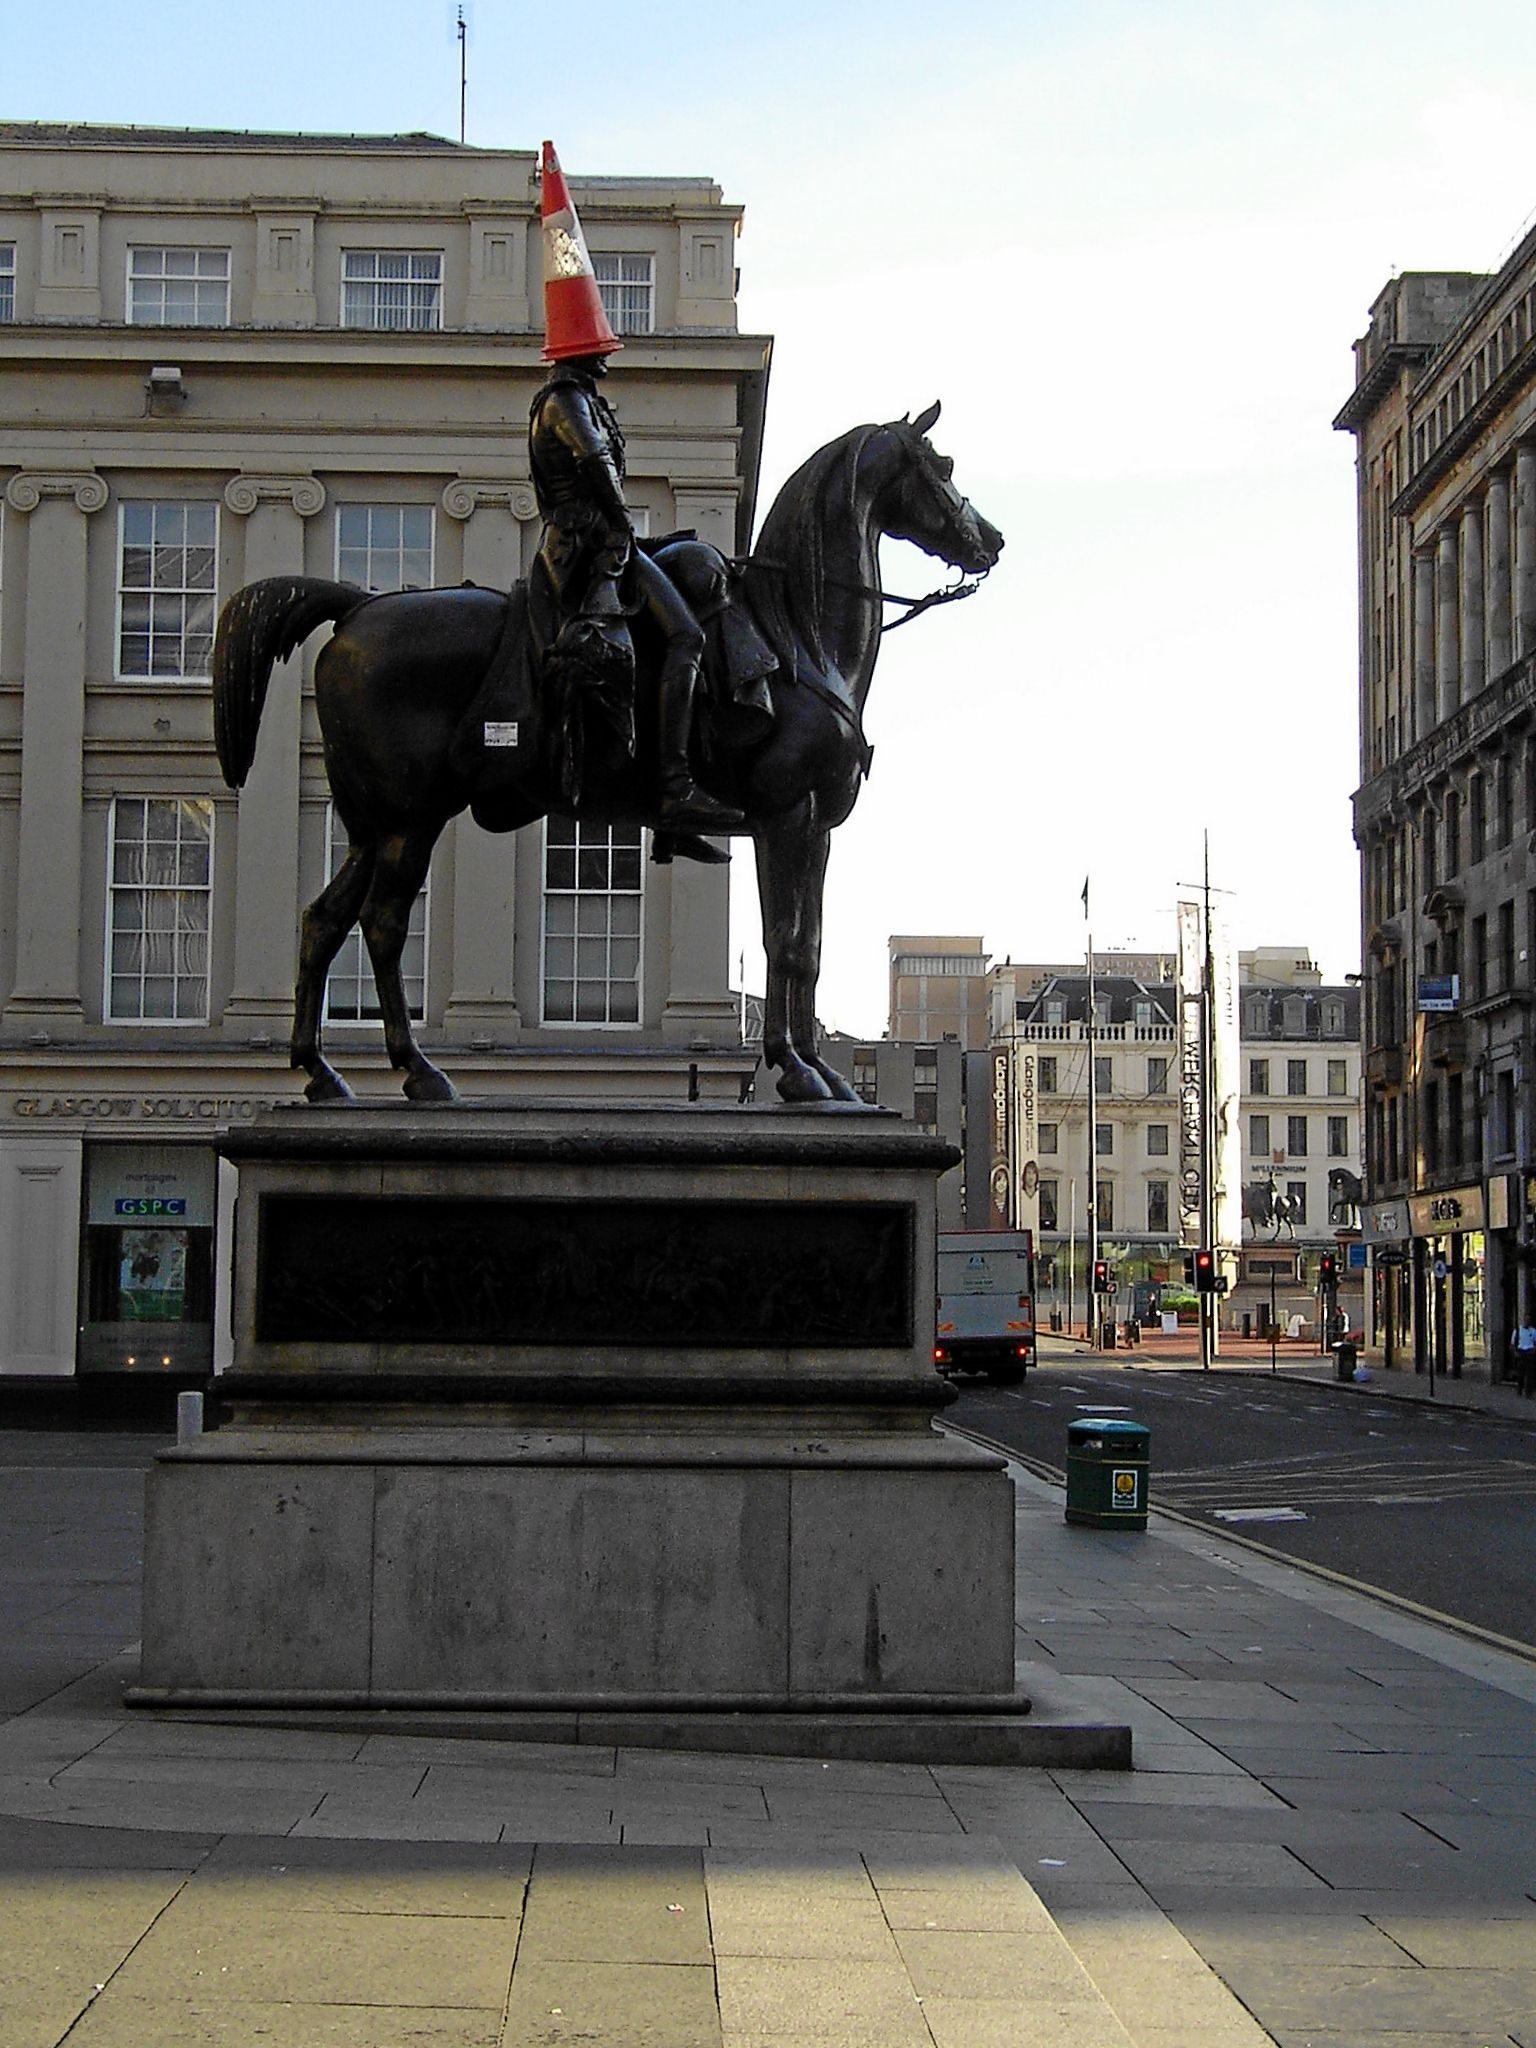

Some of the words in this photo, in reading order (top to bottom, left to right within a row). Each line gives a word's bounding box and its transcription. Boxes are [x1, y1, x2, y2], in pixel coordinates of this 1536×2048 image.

[14, 1098, 136, 1118] GLASGOW
[992, 1055, 1007, 1122] Glasgow
[1023, 1055, 1035, 1121] Glasgow
[121, 1199, 180, 1214] GSPC
